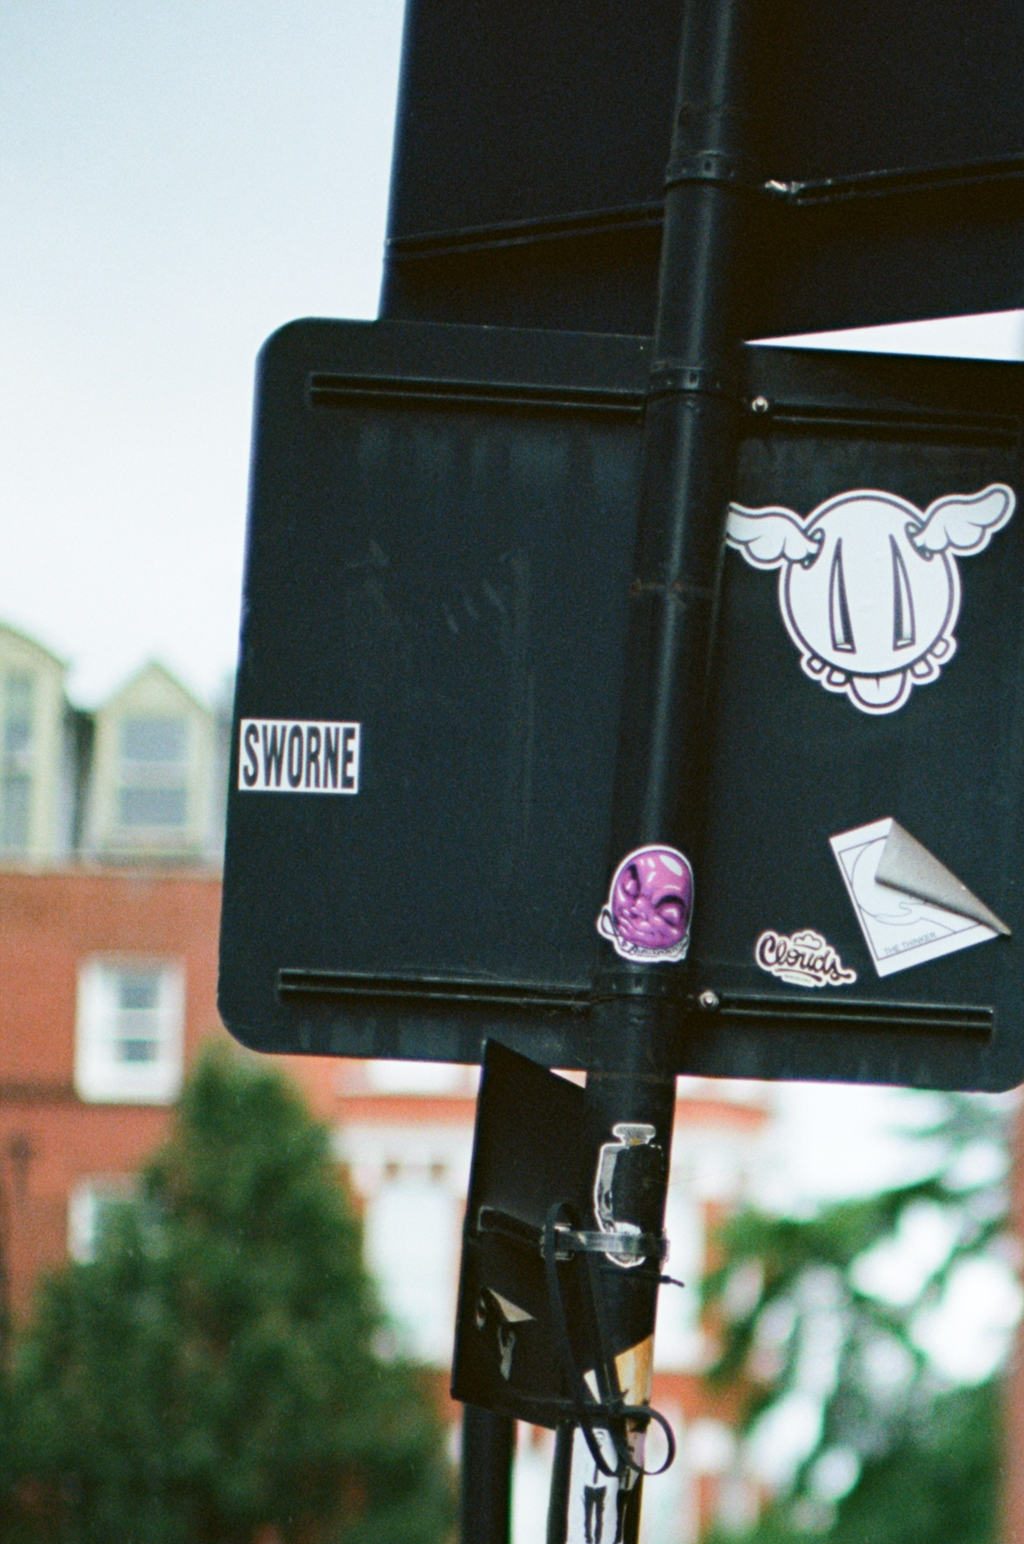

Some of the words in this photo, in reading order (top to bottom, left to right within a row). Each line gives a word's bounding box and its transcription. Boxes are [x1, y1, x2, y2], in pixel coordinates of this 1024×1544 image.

[243, 723, 356, 789] SWORNE
[759, 935, 852, 980] Clouds
[884, 944, 900, 956] THE
[901, 932, 937, 949] THINKER
